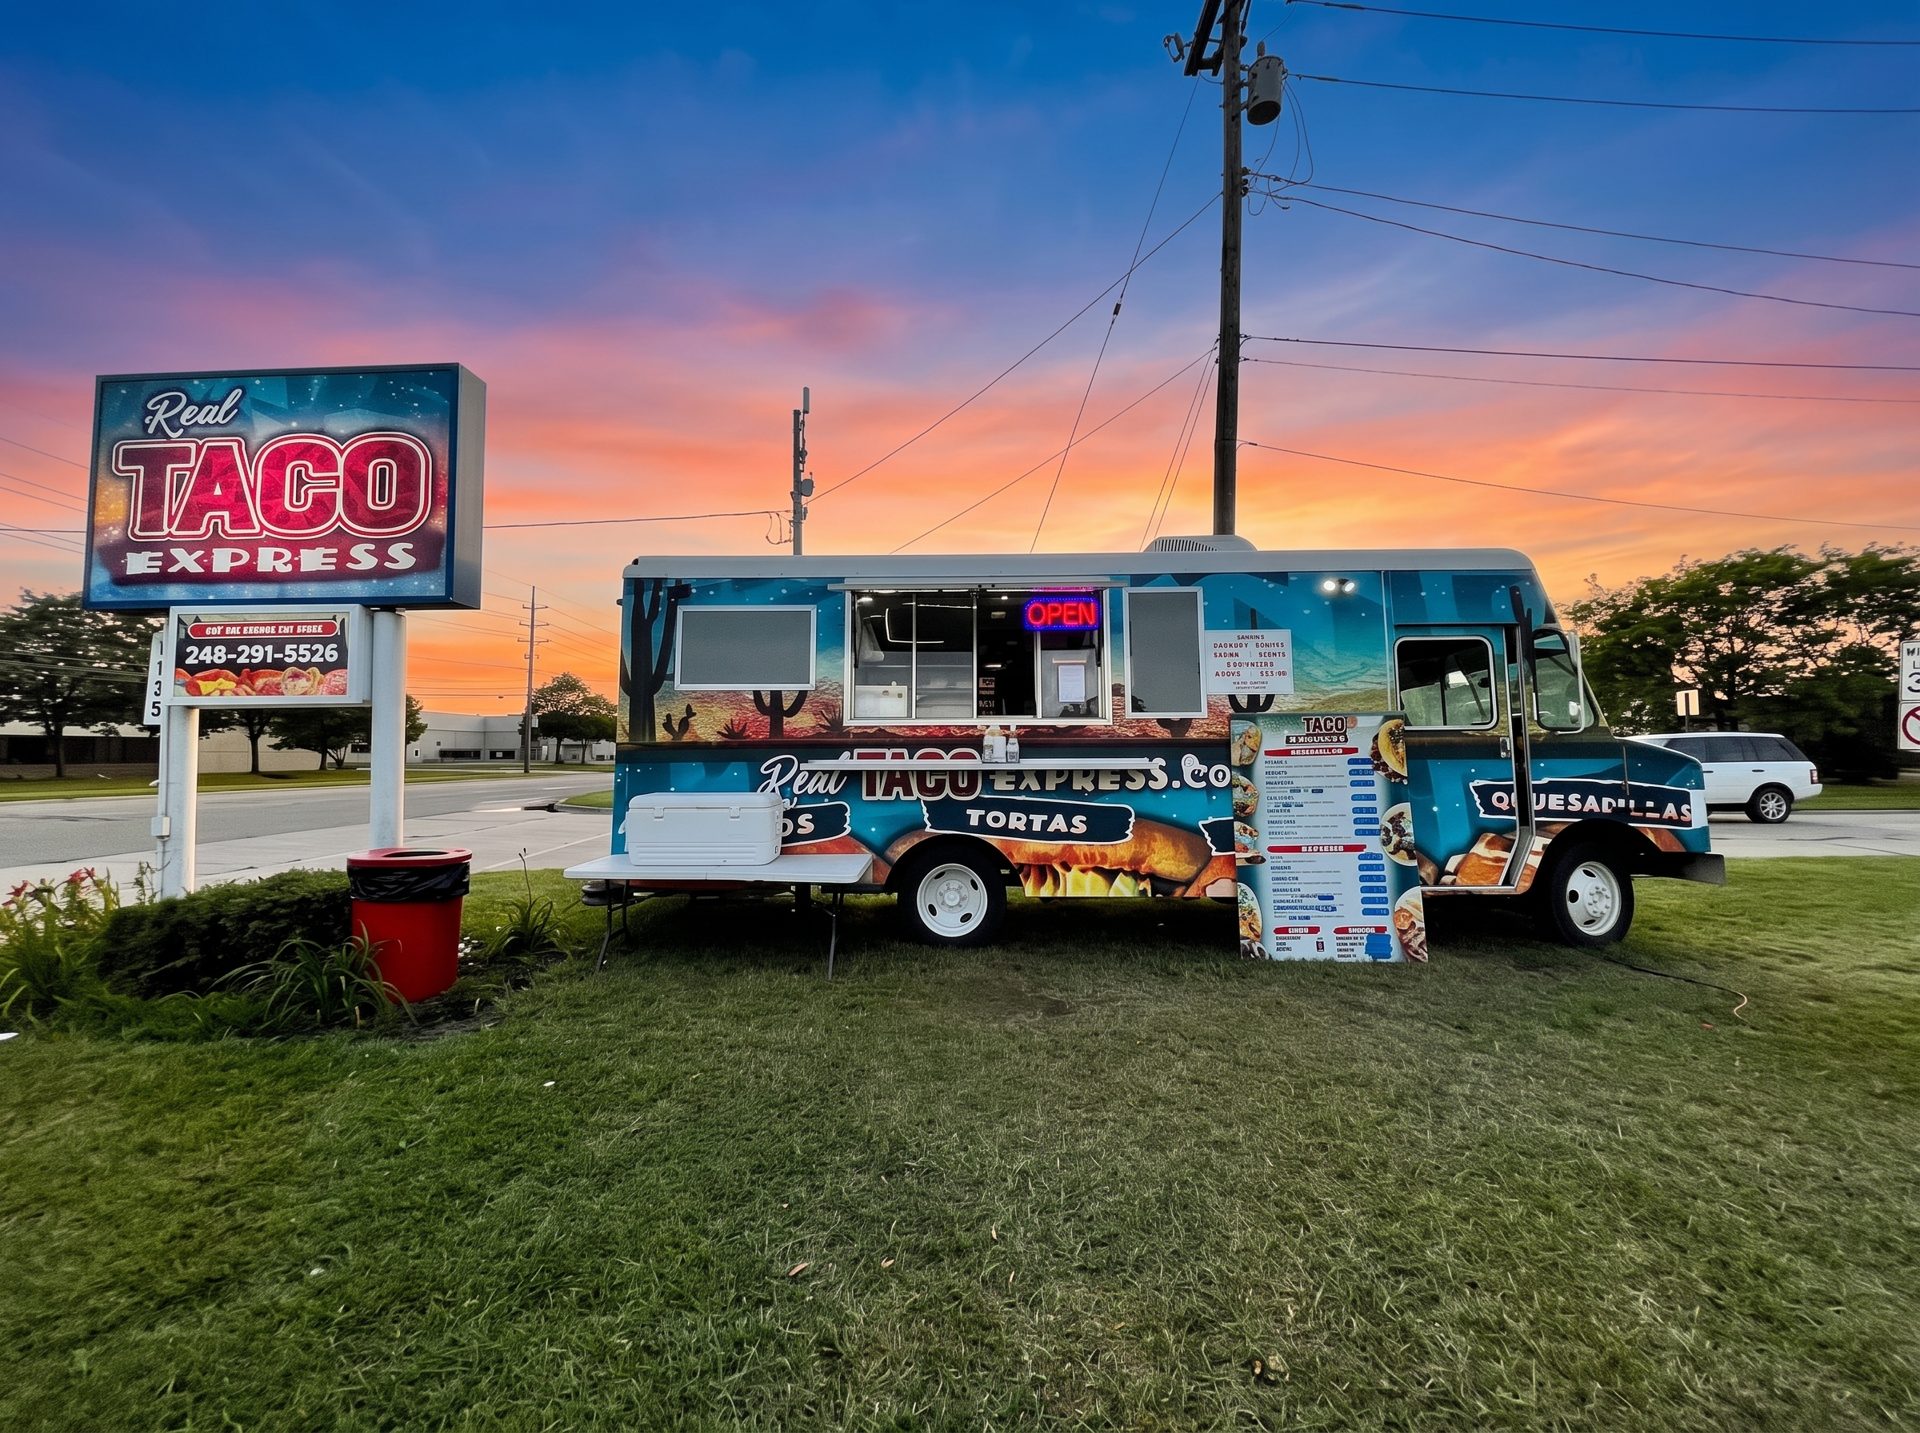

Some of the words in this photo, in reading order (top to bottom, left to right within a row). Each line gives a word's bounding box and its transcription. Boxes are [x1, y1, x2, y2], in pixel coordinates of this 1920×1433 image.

[145, 388, 242, 438] Real
[113, 432, 432, 540] TACO
[125, 543, 417, 575] EXPRESS
[1027, 602, 1097, 625] OPEN
[185, 643, 338, 664] 248-291-5526
[1302, 716, 1346, 734] TACO
[757, 751, 850, 806] Real
[855, 748, 983, 801] TACO
[966, 809, 1088, 834] TORTAS
